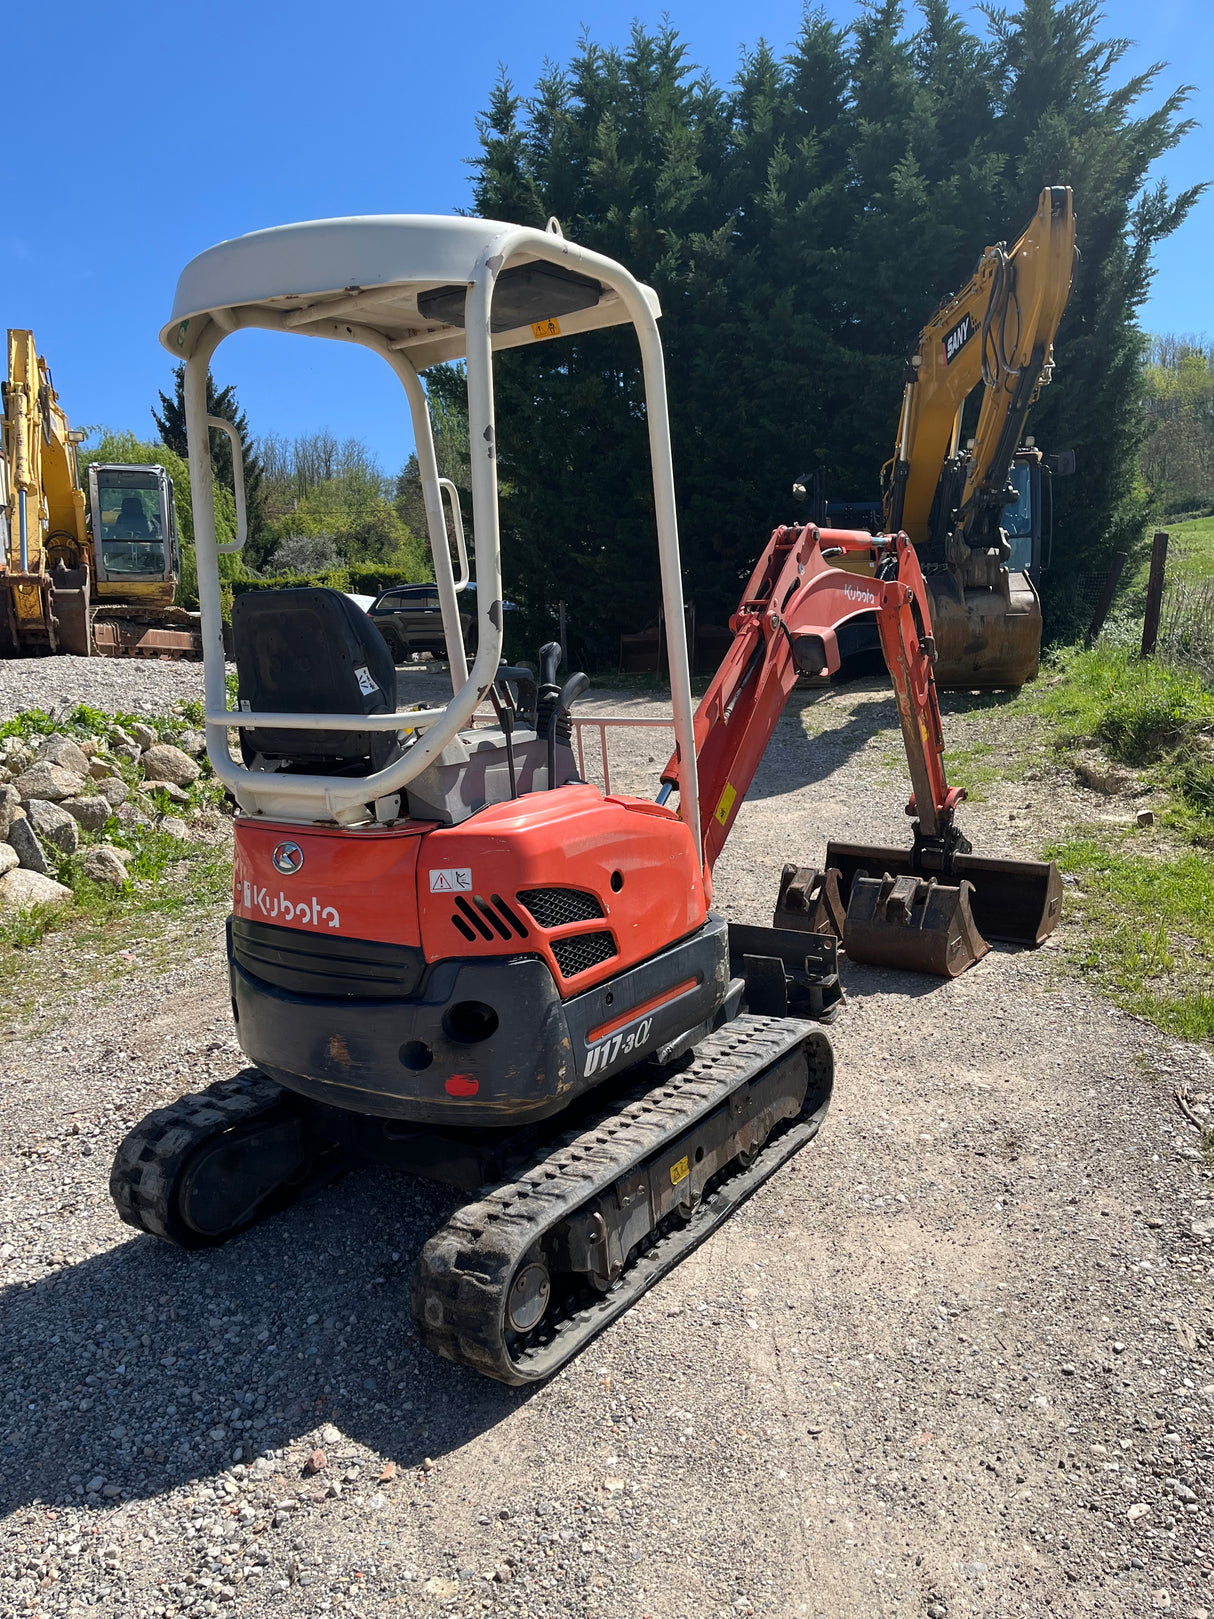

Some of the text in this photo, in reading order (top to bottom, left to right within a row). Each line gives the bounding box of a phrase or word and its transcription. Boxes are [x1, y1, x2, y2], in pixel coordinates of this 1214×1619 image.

[947, 317, 969, 359] SANY
[844, 583, 875, 604] Kubota
[253, 885, 340, 928] Kubota
